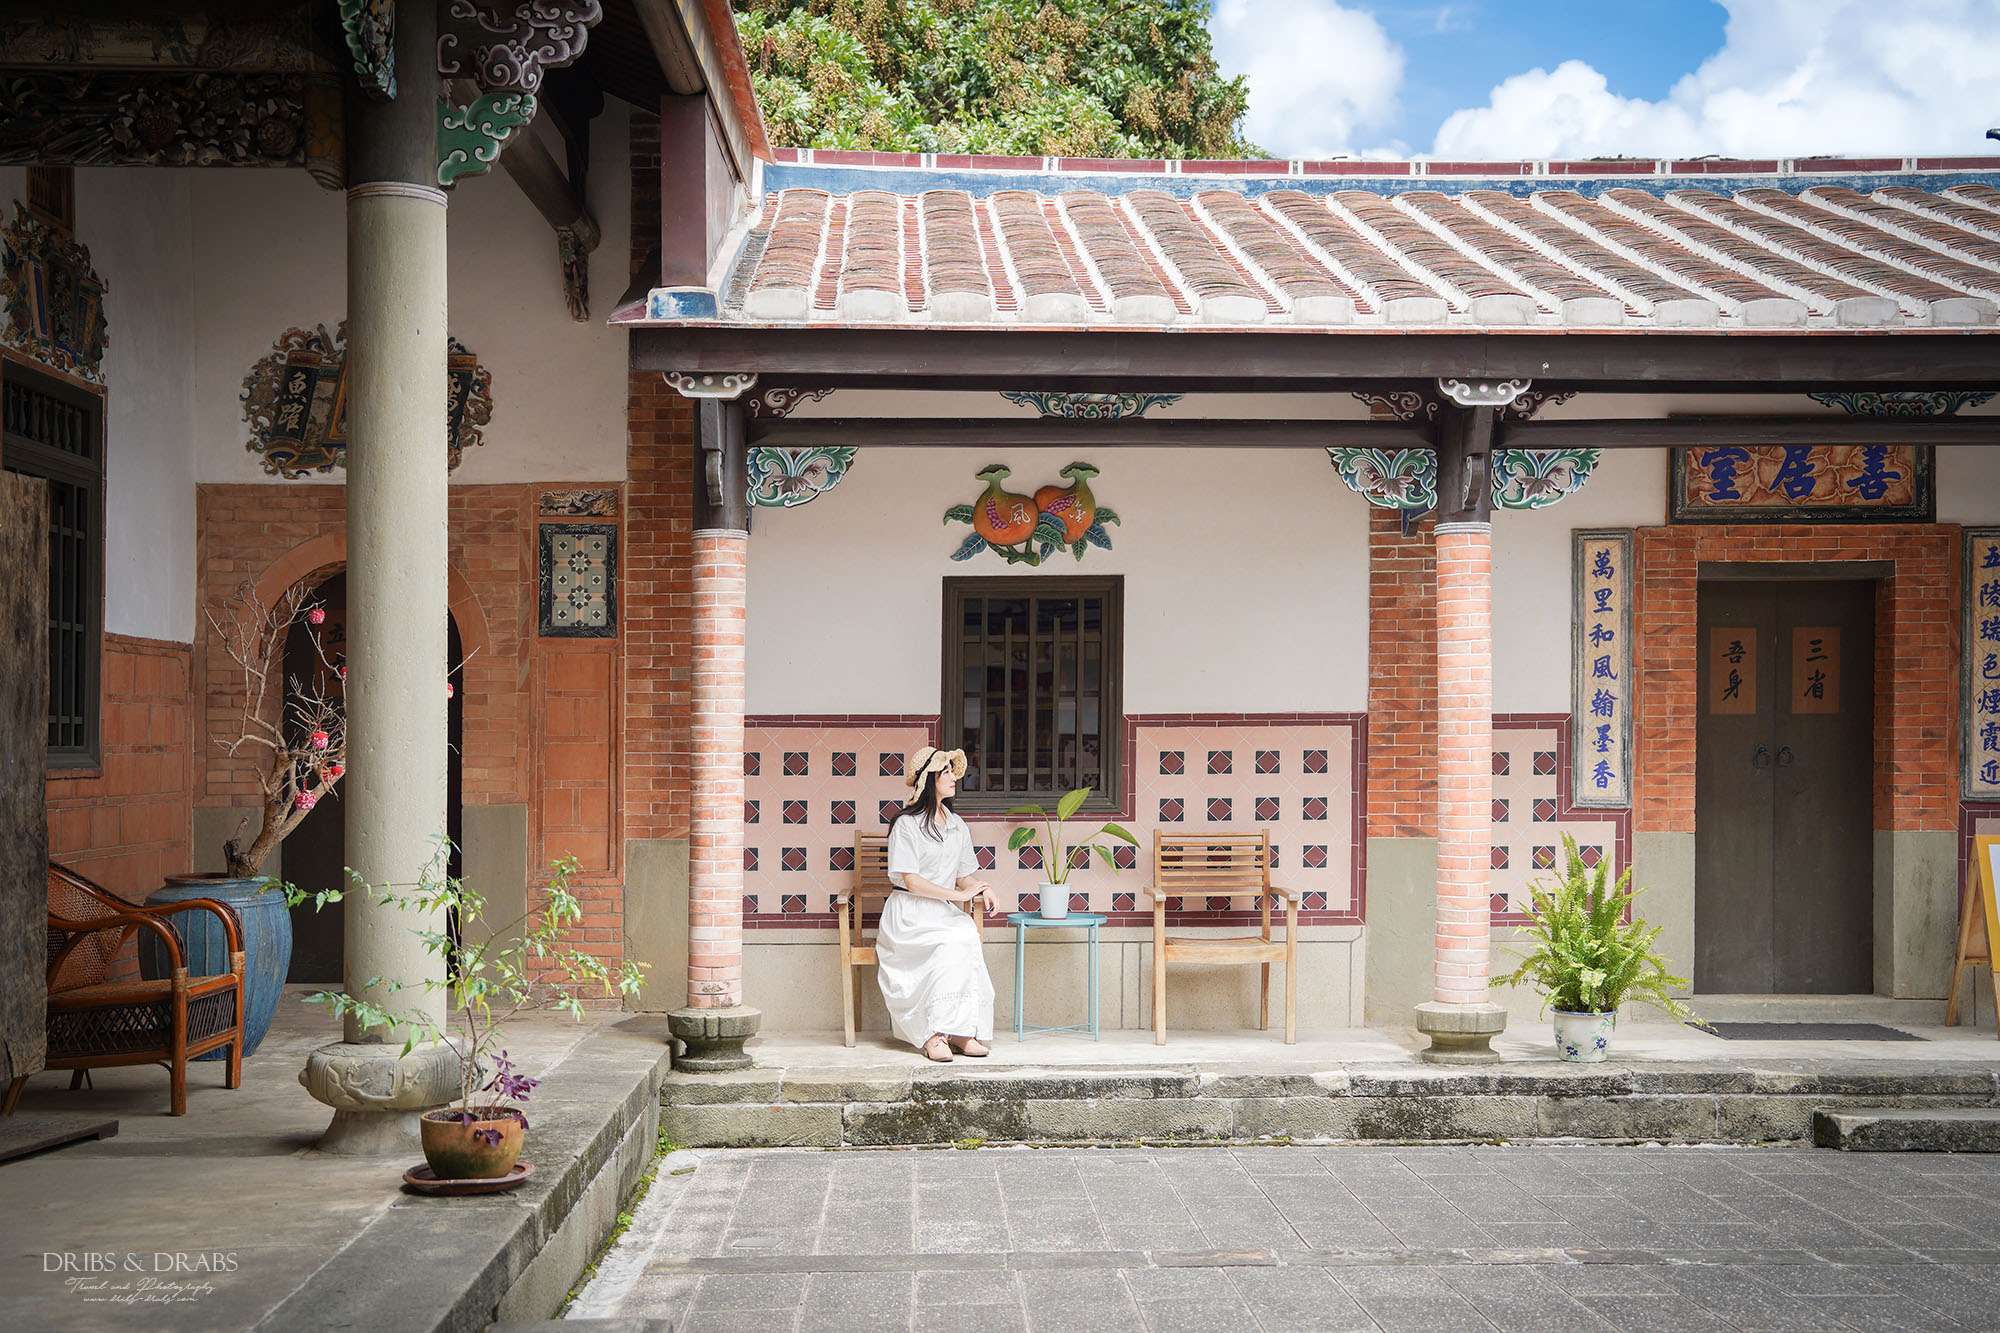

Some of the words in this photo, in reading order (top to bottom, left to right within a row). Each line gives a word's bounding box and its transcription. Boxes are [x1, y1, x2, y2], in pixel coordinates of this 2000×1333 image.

[1589, 549, 1618, 789] 萬里和風翰墨香
[1721, 640, 1746, 701] 吾身
[1803, 639, 1828, 700] 三省
